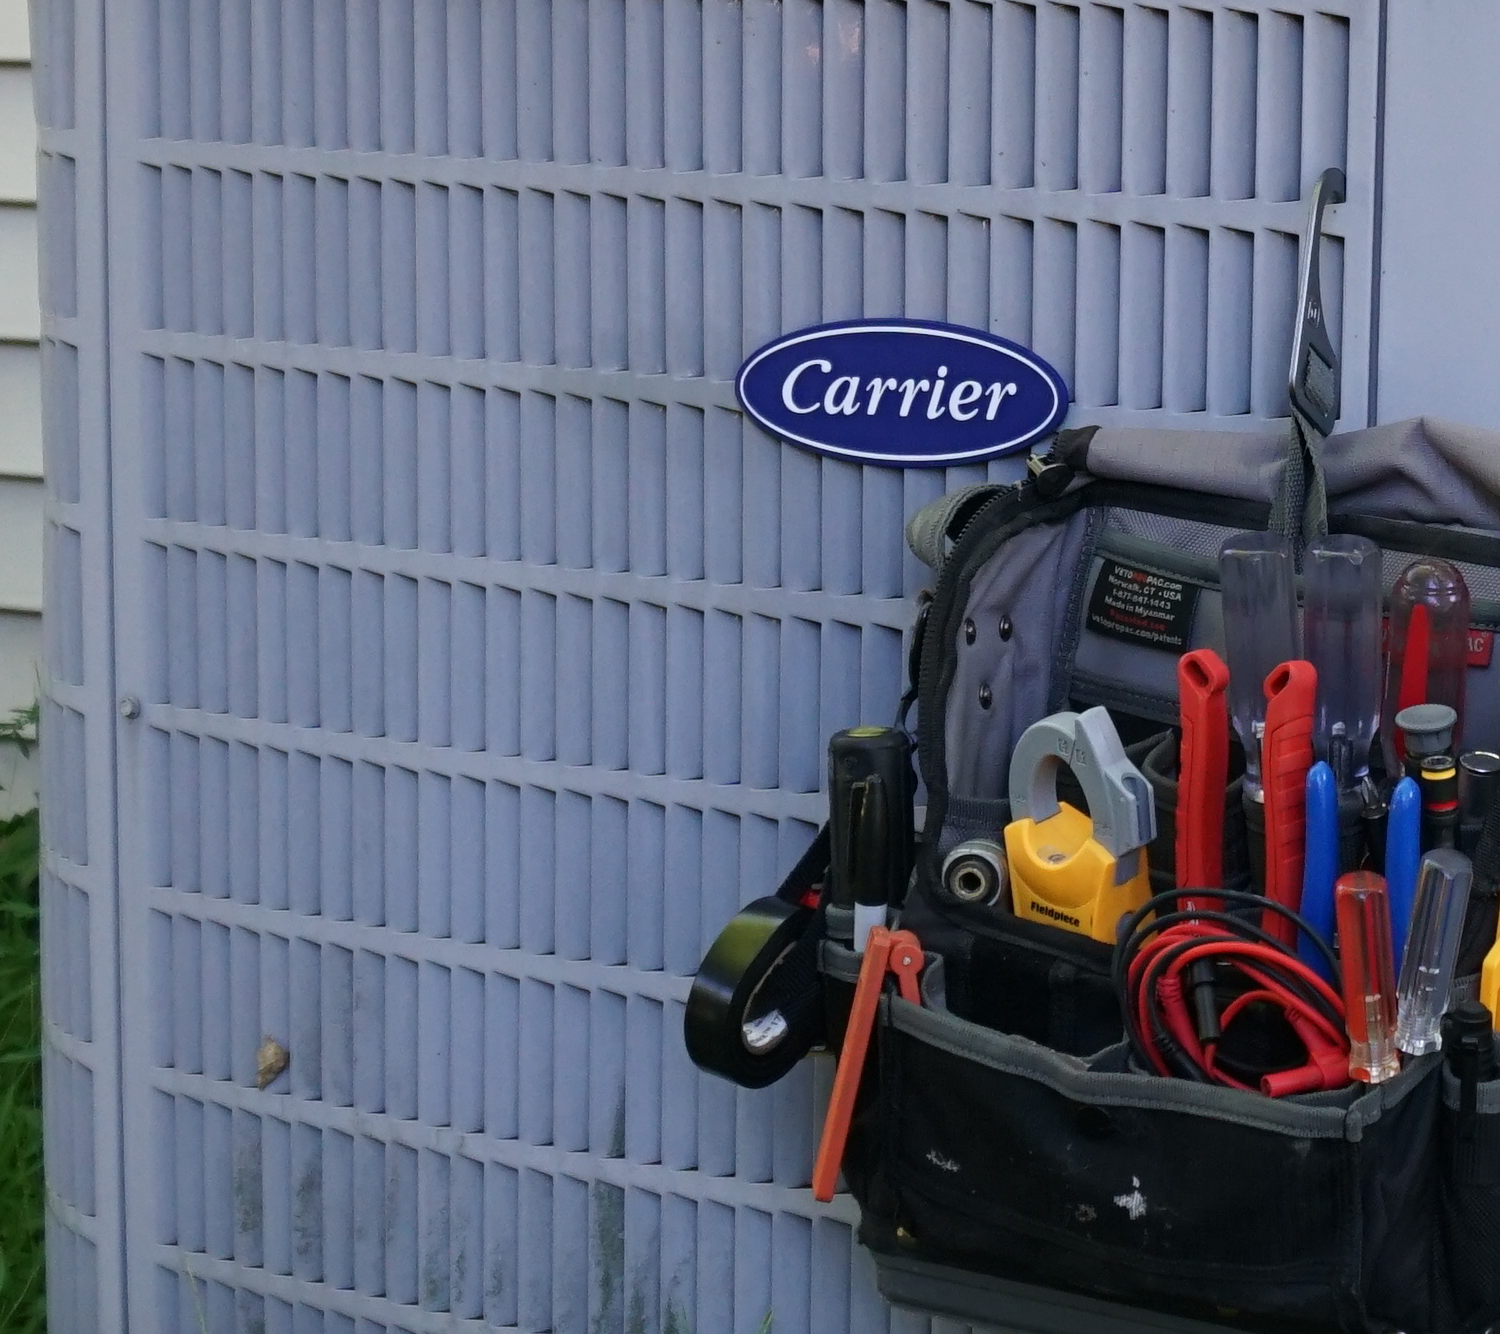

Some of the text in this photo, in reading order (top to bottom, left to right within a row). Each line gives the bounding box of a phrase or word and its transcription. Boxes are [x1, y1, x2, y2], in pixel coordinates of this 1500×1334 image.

[781, 359, 1017, 422] Carrier
[1143, 586, 1156, 596] CT
[1163, 590, 1182, 602] USA
[1104, 595, 1176, 622] Made in Myanmar
[1030, 901, 1080, 927] Fieldpiece
